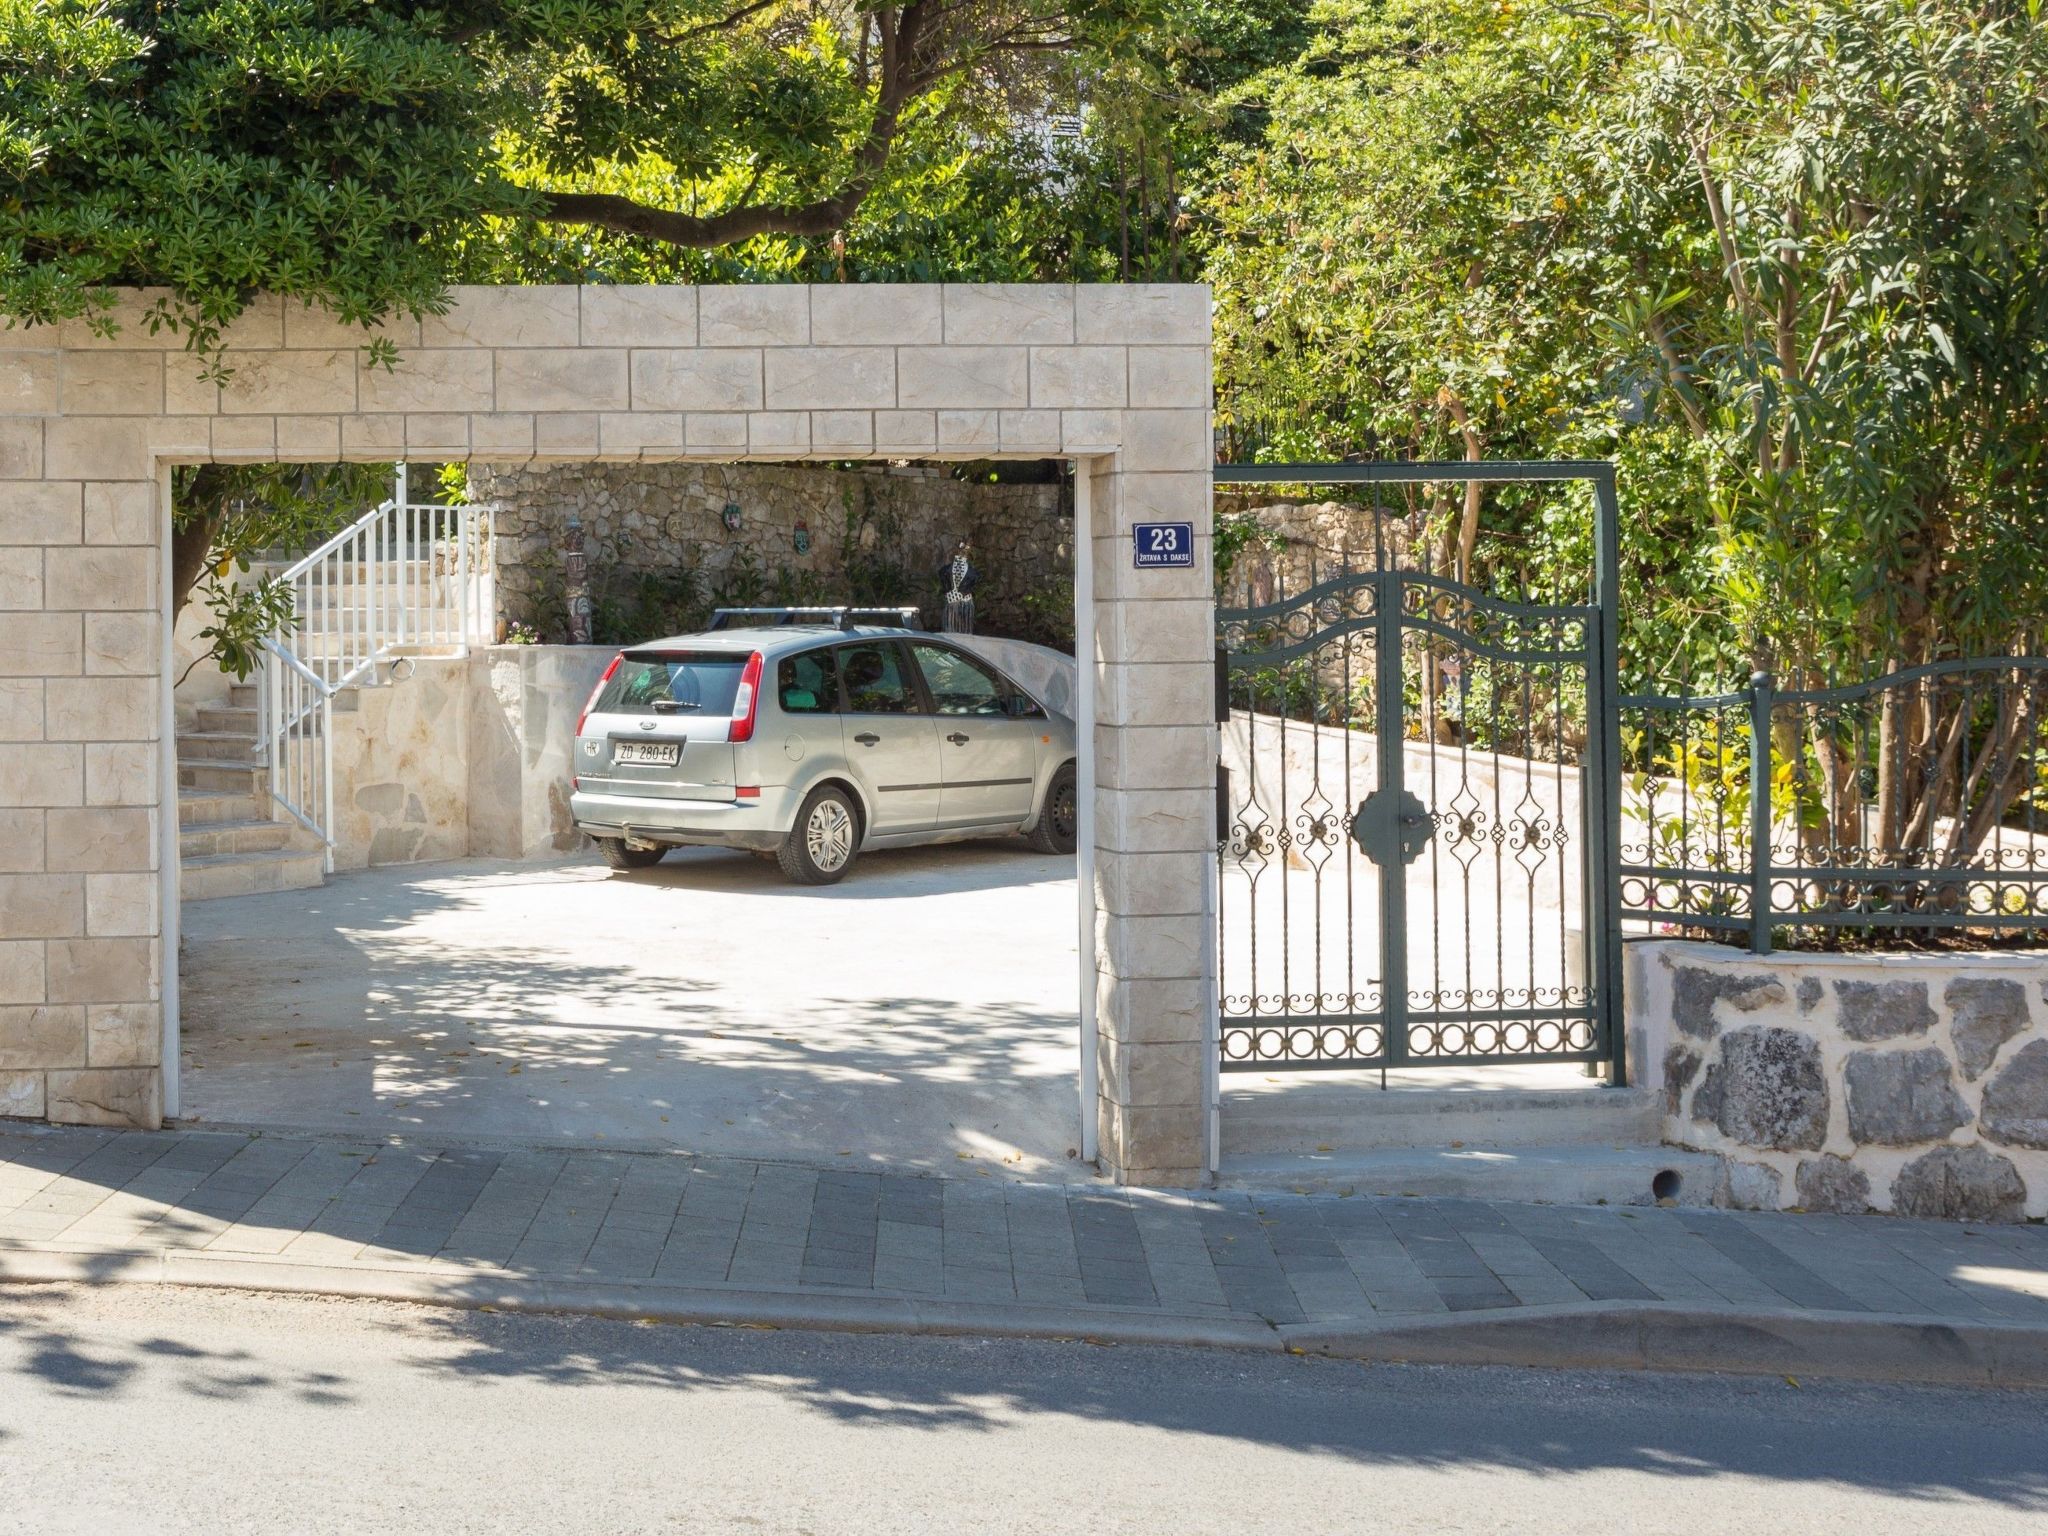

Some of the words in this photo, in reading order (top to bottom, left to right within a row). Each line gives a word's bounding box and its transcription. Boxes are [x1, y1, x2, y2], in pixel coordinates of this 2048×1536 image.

[1151, 528, 1177, 551] 23
[1139, 553, 1161, 561] ŽRTAVA
[586, 742, 597, 753] HR
[620, 745, 633, 759] ZD
